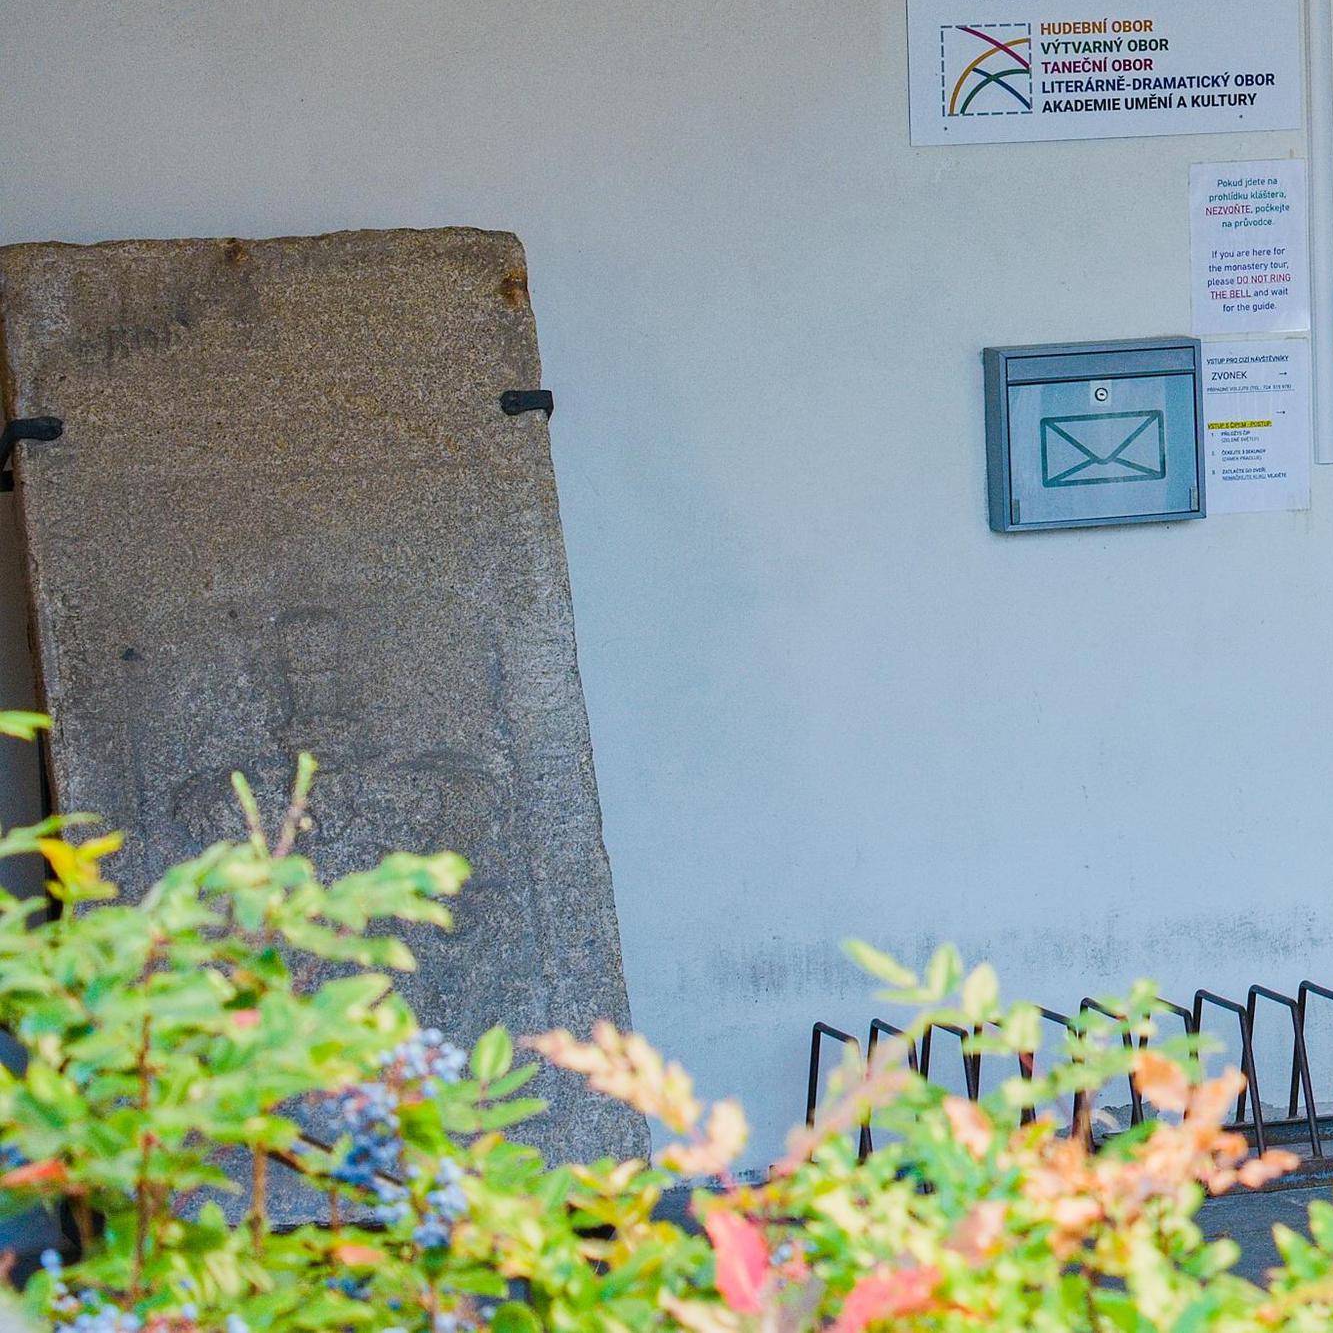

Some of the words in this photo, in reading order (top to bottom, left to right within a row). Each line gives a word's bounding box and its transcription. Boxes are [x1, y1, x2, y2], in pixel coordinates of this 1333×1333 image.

[1040, 18, 1107, 36] HUDEBNÍ
[1111, 20, 1154, 33] OBOR
[1040, 37, 1124, 55] VÝTVARNÝ
[1127, 38, 1169, 52] OBOR
[1041, 57, 1107, 74] TANEČNÍ
[1111, 58, 1154, 72] OBOR
[1041, 72, 1230, 94] LITERÁRNĚ-DRAMATICKÝ
[1234, 73, 1276, 87] OBOR
[1042, 98, 1121, 113] AKADEMIE
[1124, 94, 1173, 111] UMĚNÍ
[1176, 95, 1188, 108] A
[1191, 93, 1258, 108] KULTURY
[1217, 178, 1243, 187] Pokud
[1245, 178, 1266, 188] jdete
[1209, 191, 1248, 203] prohlídku
[1250, 190, 1287, 200] kláštera,
[1205, 204, 1253, 216] NEZVOŇTE,
[1255, 203, 1290, 214] počkejte
[1211, 250, 1218, 259] If
[1219, 252, 1235, 260] you
[1252, 248, 1272, 256] here
[1273, 247, 1286, 255] for
[1208, 264, 1222, 272] the
[1224, 263, 1269, 272] monastery
[1270, 261, 1289, 270] tour,
[1207, 278, 1235, 287] please
[1236, 276, 1248, 284] DO
[1251, 275, 1269, 284] NOT
[1270, 273, 1292, 282] RING
[1210, 290, 1227, 299] THE
[1229, 289, 1251, 299] BELL
[1271, 288, 1289, 296] wait
[1223, 304, 1235, 312] for
[1237, 303, 1250, 311] the
[1252, 302, 1277, 312] guide.
[1206, 357, 1226, 365] VSTUP
[1211, 371, 1248, 381] ZVONEK
